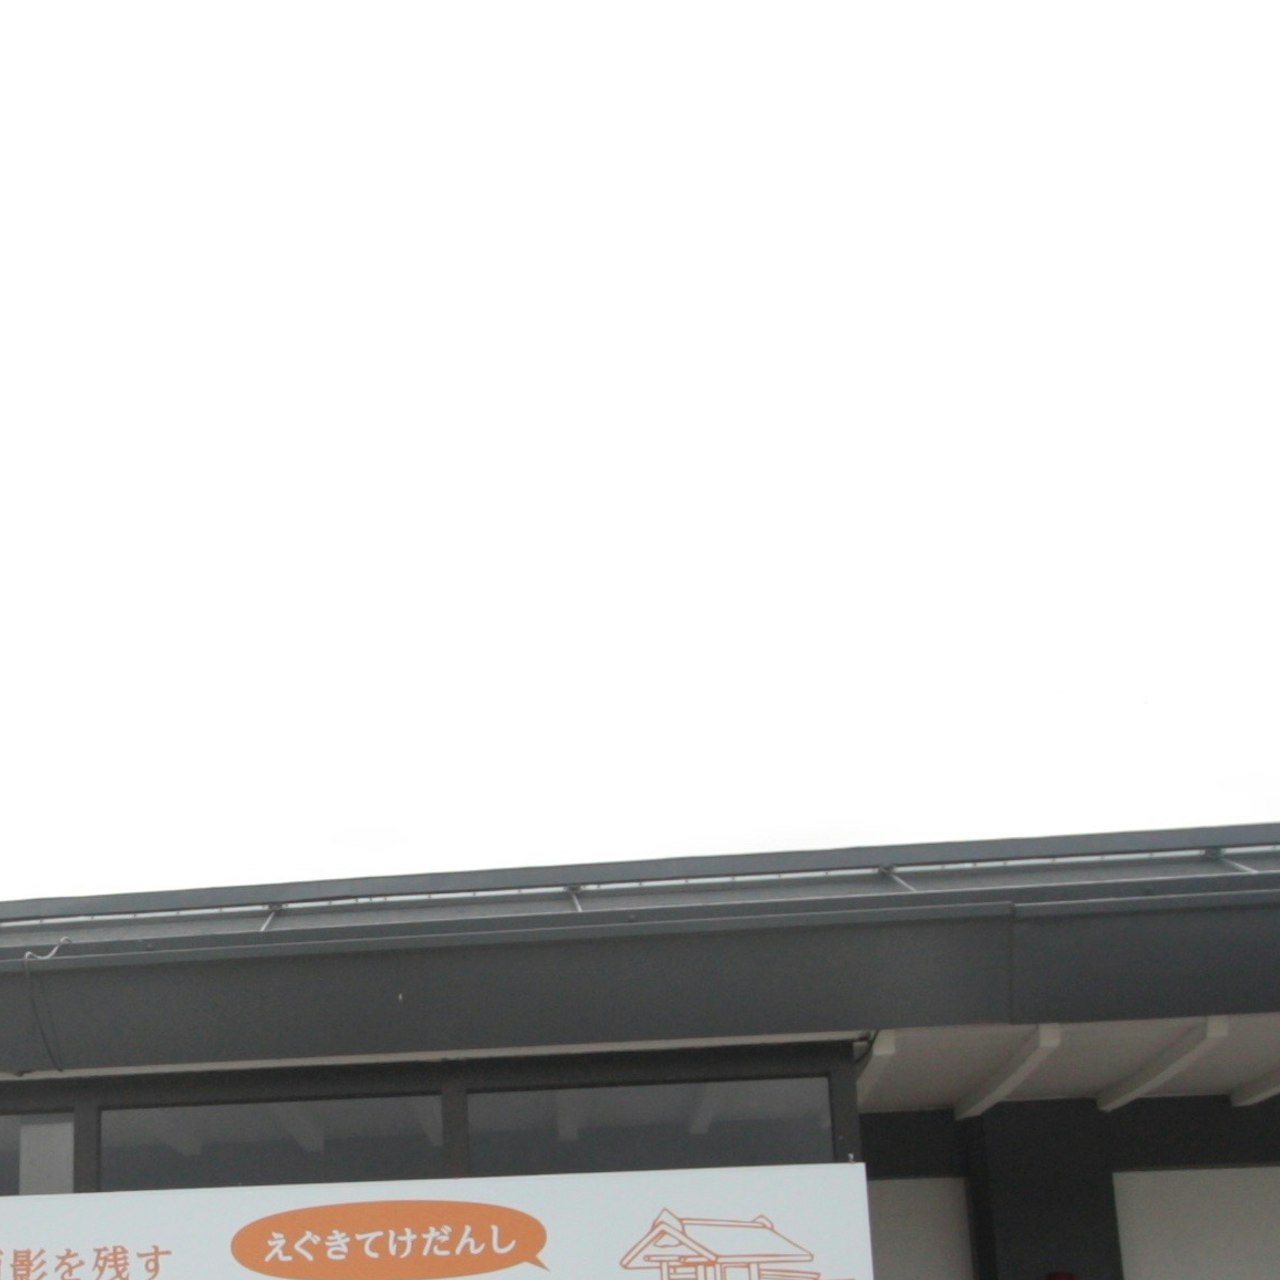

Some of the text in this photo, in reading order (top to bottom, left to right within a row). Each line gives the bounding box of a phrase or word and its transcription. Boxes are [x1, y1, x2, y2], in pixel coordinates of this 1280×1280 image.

[265, 1224, 517, 1263] えぐきてけだんし
